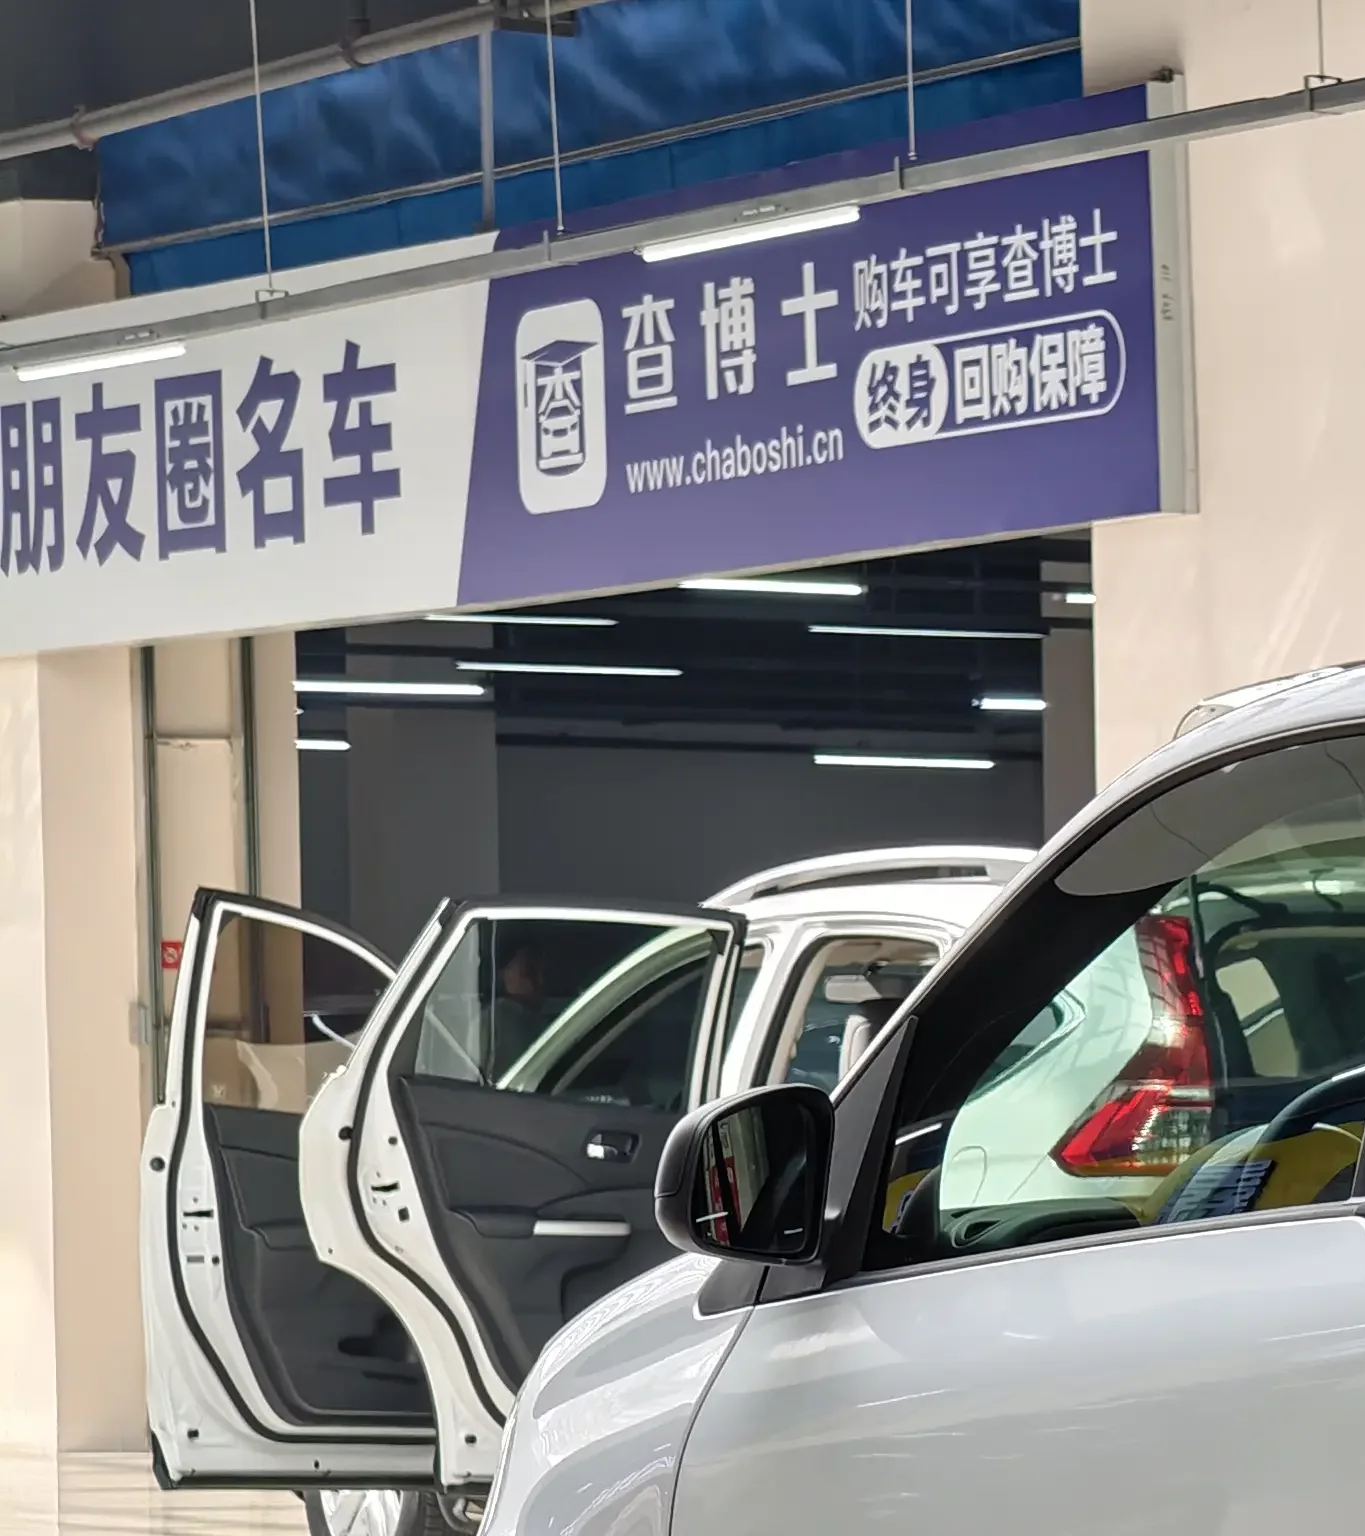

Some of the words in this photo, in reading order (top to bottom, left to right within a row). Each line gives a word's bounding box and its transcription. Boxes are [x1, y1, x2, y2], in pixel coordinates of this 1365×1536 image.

[622, 261, 839, 415] 查博士
[853, 208, 1117, 332] 购车可享查博士
[0, 340, 402, 577] 朋友圈名车
[626, 424, 843, 493] www.chaboshi.cn
